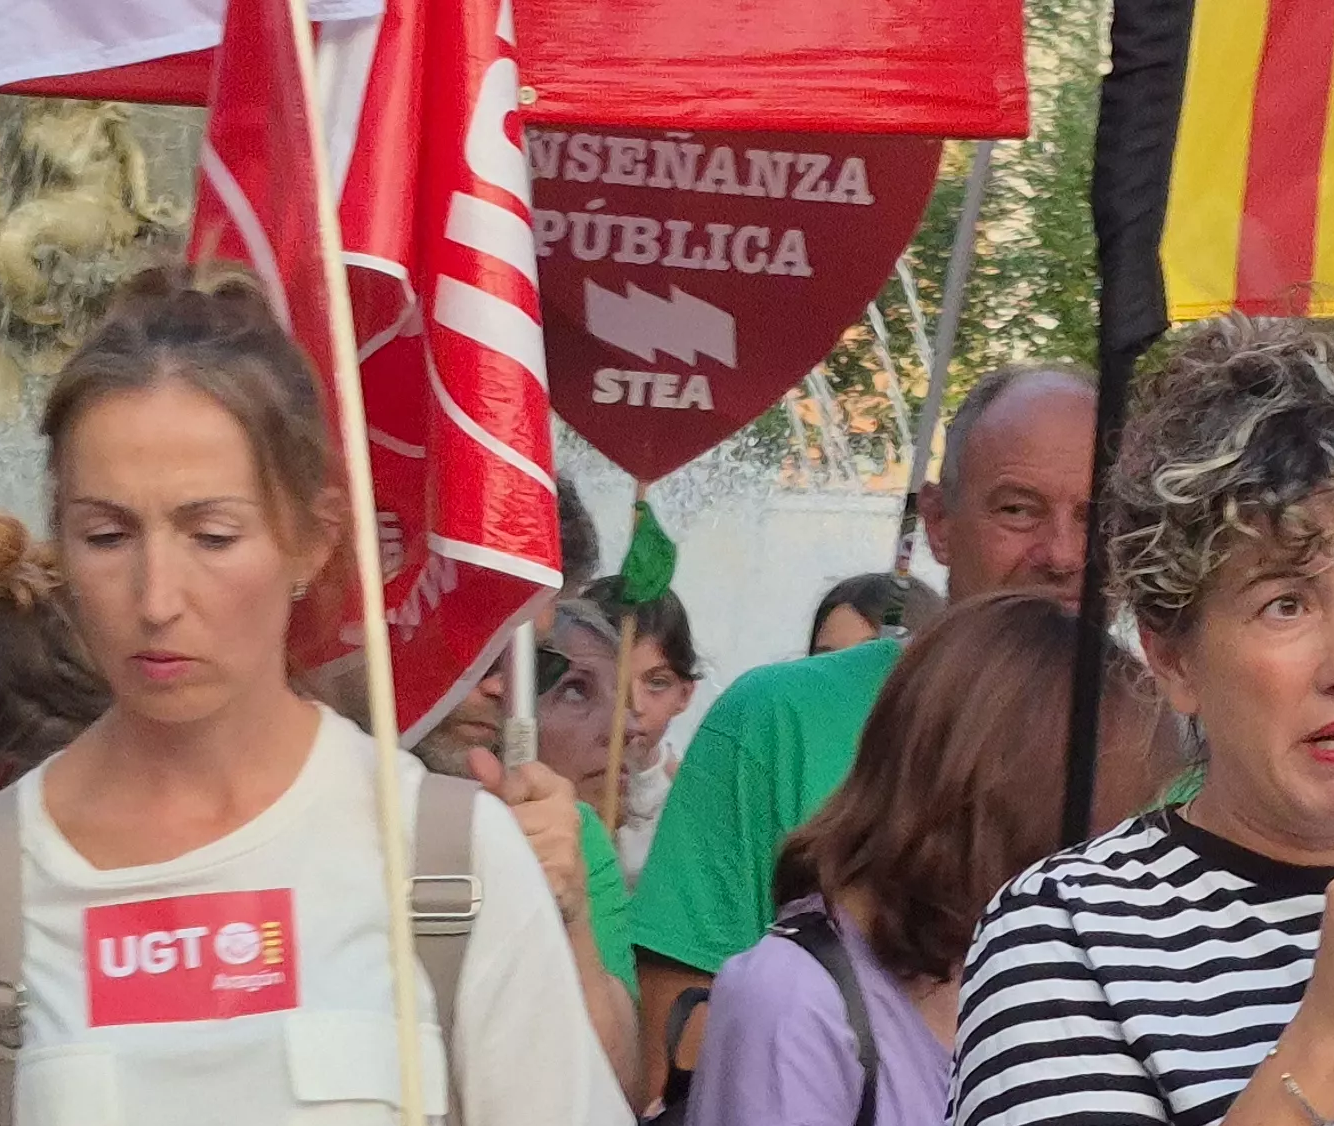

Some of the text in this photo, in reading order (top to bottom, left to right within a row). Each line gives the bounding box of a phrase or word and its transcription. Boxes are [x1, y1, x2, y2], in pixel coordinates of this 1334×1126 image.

[527, 129, 876, 207] NSEÑANZA
[533, 197, 814, 278] PÚBLICA
[591, 367, 715, 411] STEA
[99, 926, 210, 978] UGT
